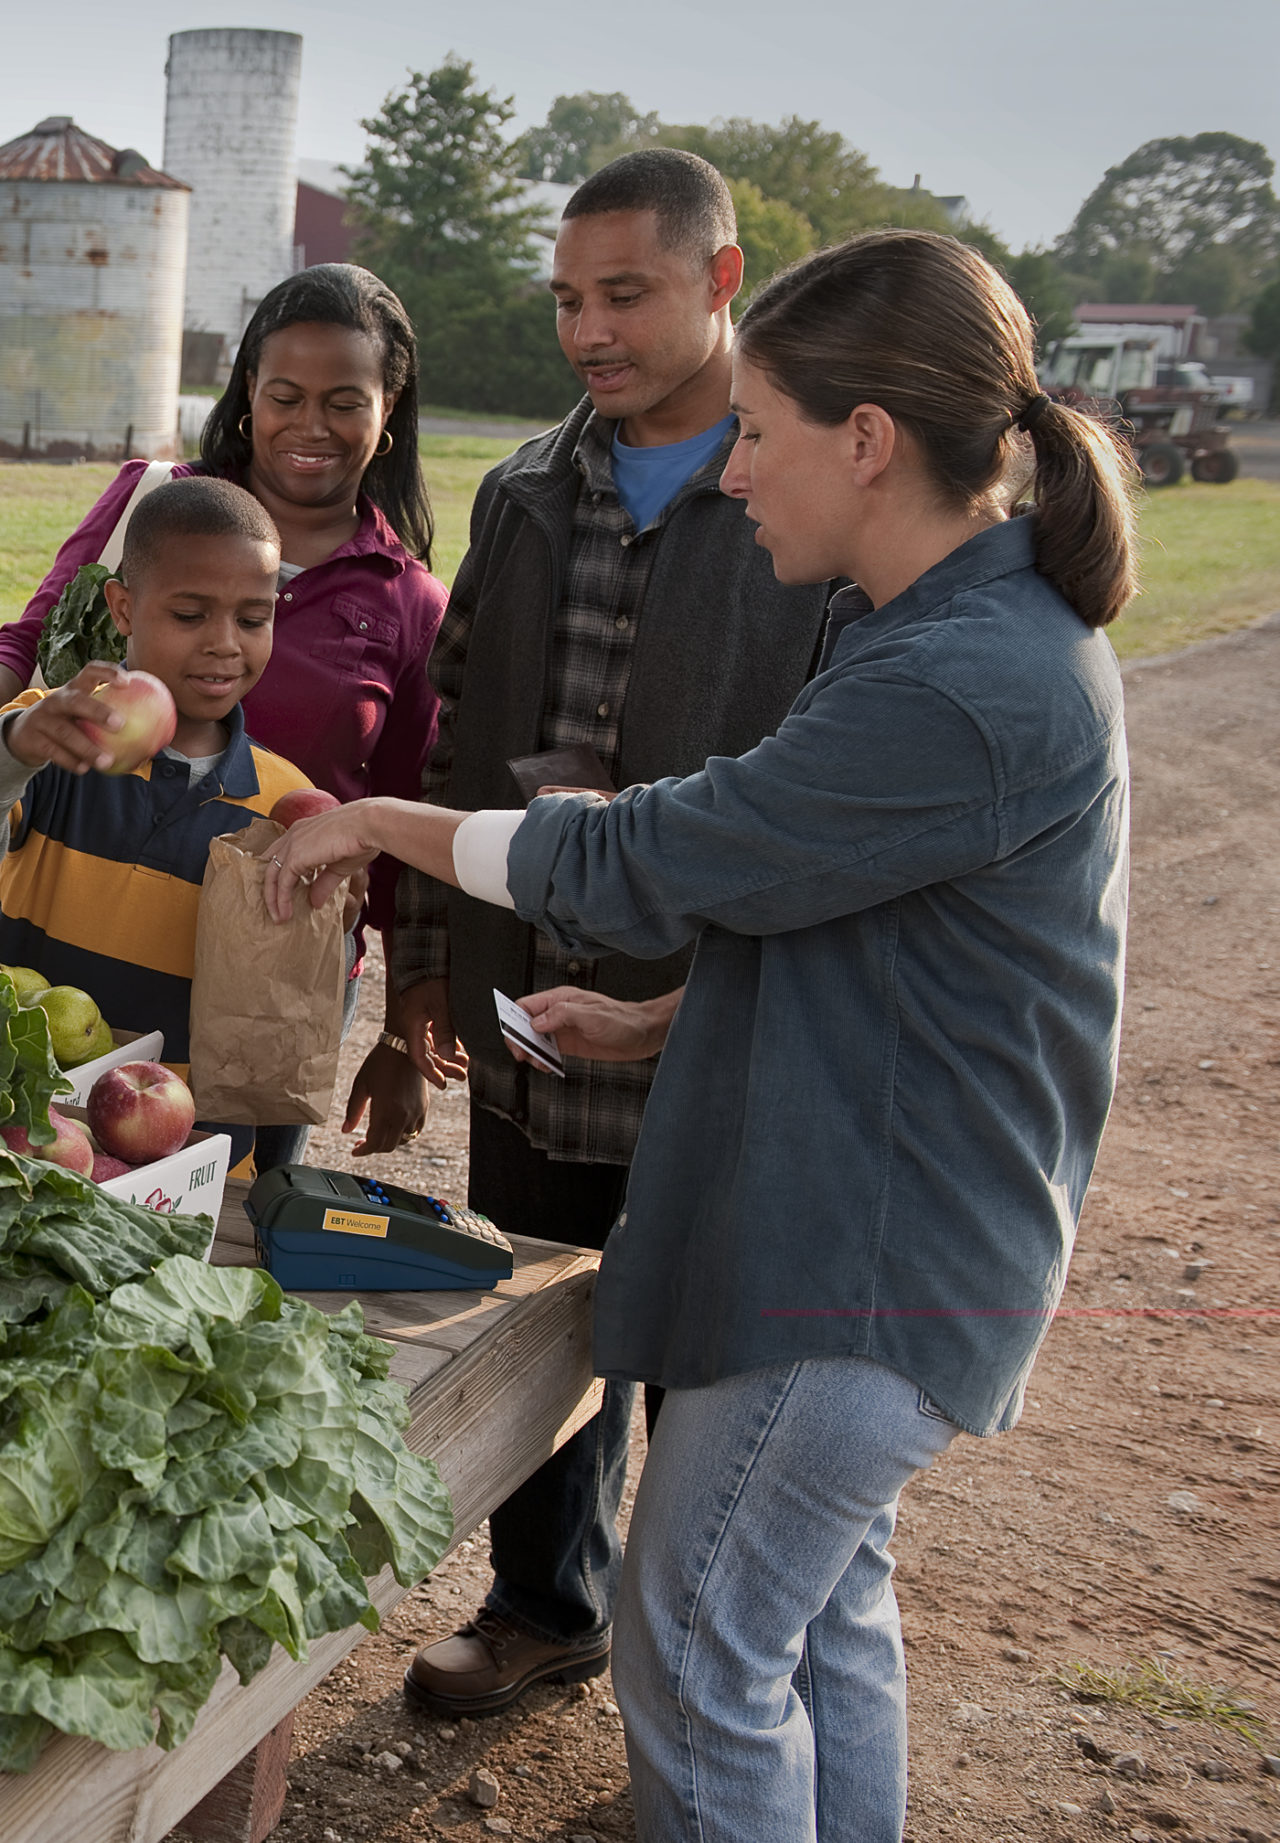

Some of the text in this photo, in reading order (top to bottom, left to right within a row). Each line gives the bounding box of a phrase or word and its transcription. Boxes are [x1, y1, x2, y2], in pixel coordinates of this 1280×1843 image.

[189, 1160, 218, 1191] FRUIT
[331, 1217, 382, 1230] EBT Welcome
